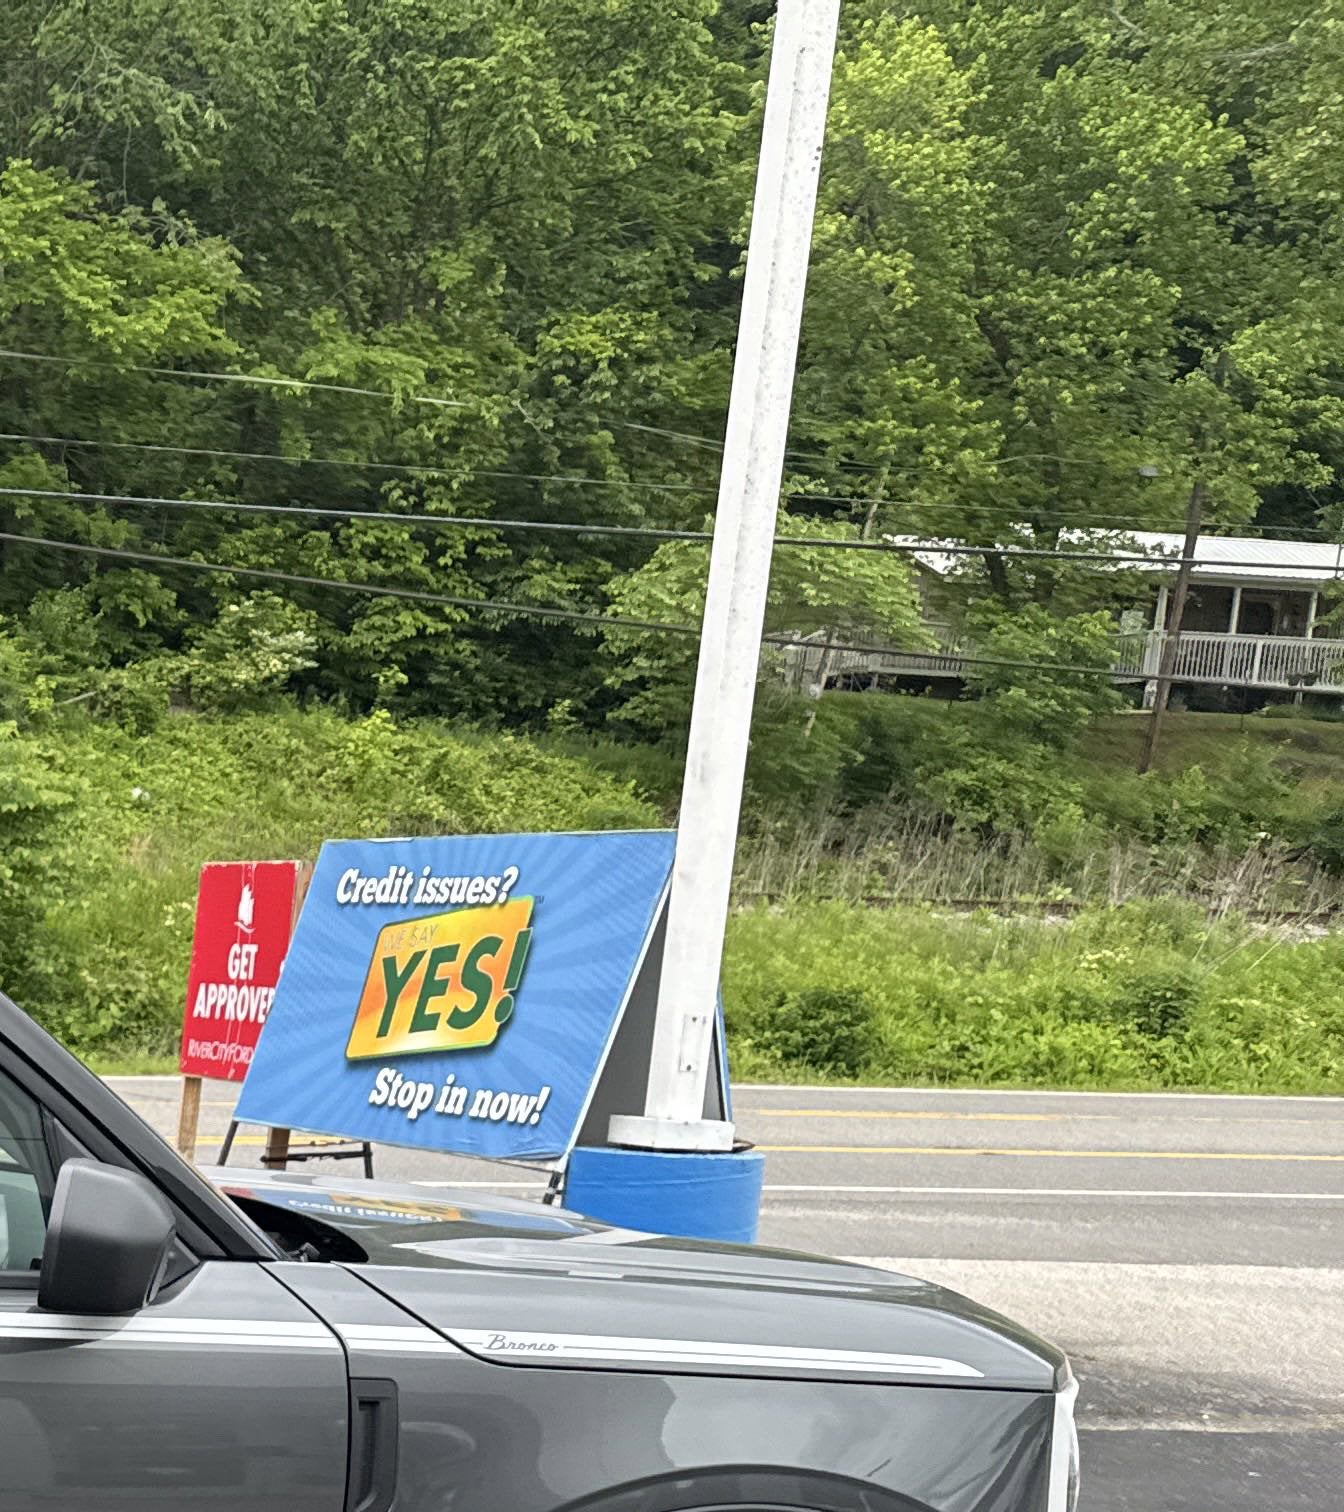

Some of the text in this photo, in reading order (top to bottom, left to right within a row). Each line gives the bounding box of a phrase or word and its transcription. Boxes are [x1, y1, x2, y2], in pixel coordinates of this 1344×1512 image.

[336, 864, 519, 905] Credit issues?
[411, 924, 440, 948] SAY
[227, 943, 259, 980] GET
[376, 927, 534, 1039] YES!
[368, 1067, 551, 1126] Stop in now!
[485, 1334, 560, 1351] Bronco
